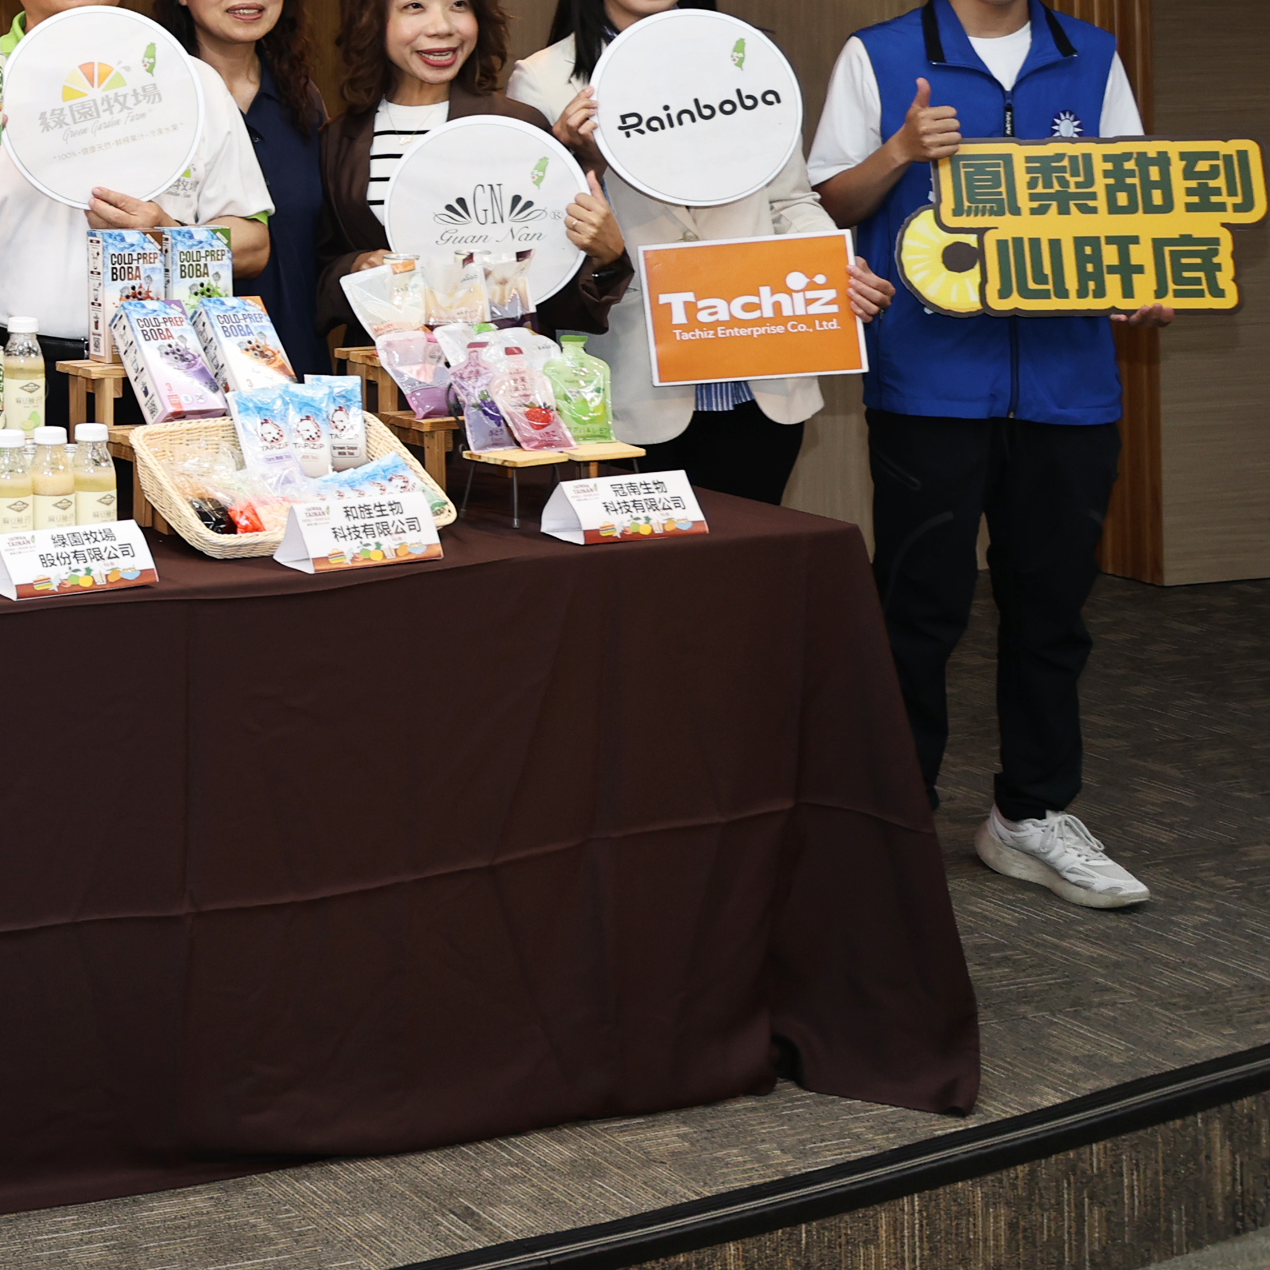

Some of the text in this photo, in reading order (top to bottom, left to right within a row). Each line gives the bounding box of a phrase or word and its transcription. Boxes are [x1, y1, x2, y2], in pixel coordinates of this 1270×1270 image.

[38, 83, 163, 133] 綠園牧場
[617, 88, 782, 139] Rainboba
[950, 149, 1256, 219] 鳳梨甜到
[473, 183, 504, 225] GN
[435, 225, 547, 246] Guan Nan
[110, 251, 158, 266] COLD-PREP
[179, 249, 226, 264] COLD-PREP
[111, 266, 141, 281] BOBA
[179, 263, 209, 279] BOBA
[996, 233, 1227, 301] 心肝底
[658, 271, 840, 324] Tachiz
[136, 316, 185, 329] COLD-PREP
[216, 313, 264, 325] COLD-PREP
[143, 328, 174, 341] BOBA
[223, 324, 254, 337] BOBA
[672, 318, 841, 341] Tachiz Enterprise Co., Ltd.
[610, 480, 668, 497] 冠南生物
[602, 496, 686, 515] 科技有限公司
[51, 528, 116, 548] 綠園牧場
[331, 517, 421, 542] 科技有限公司
[39, 543, 135, 568] 股份有限公司
